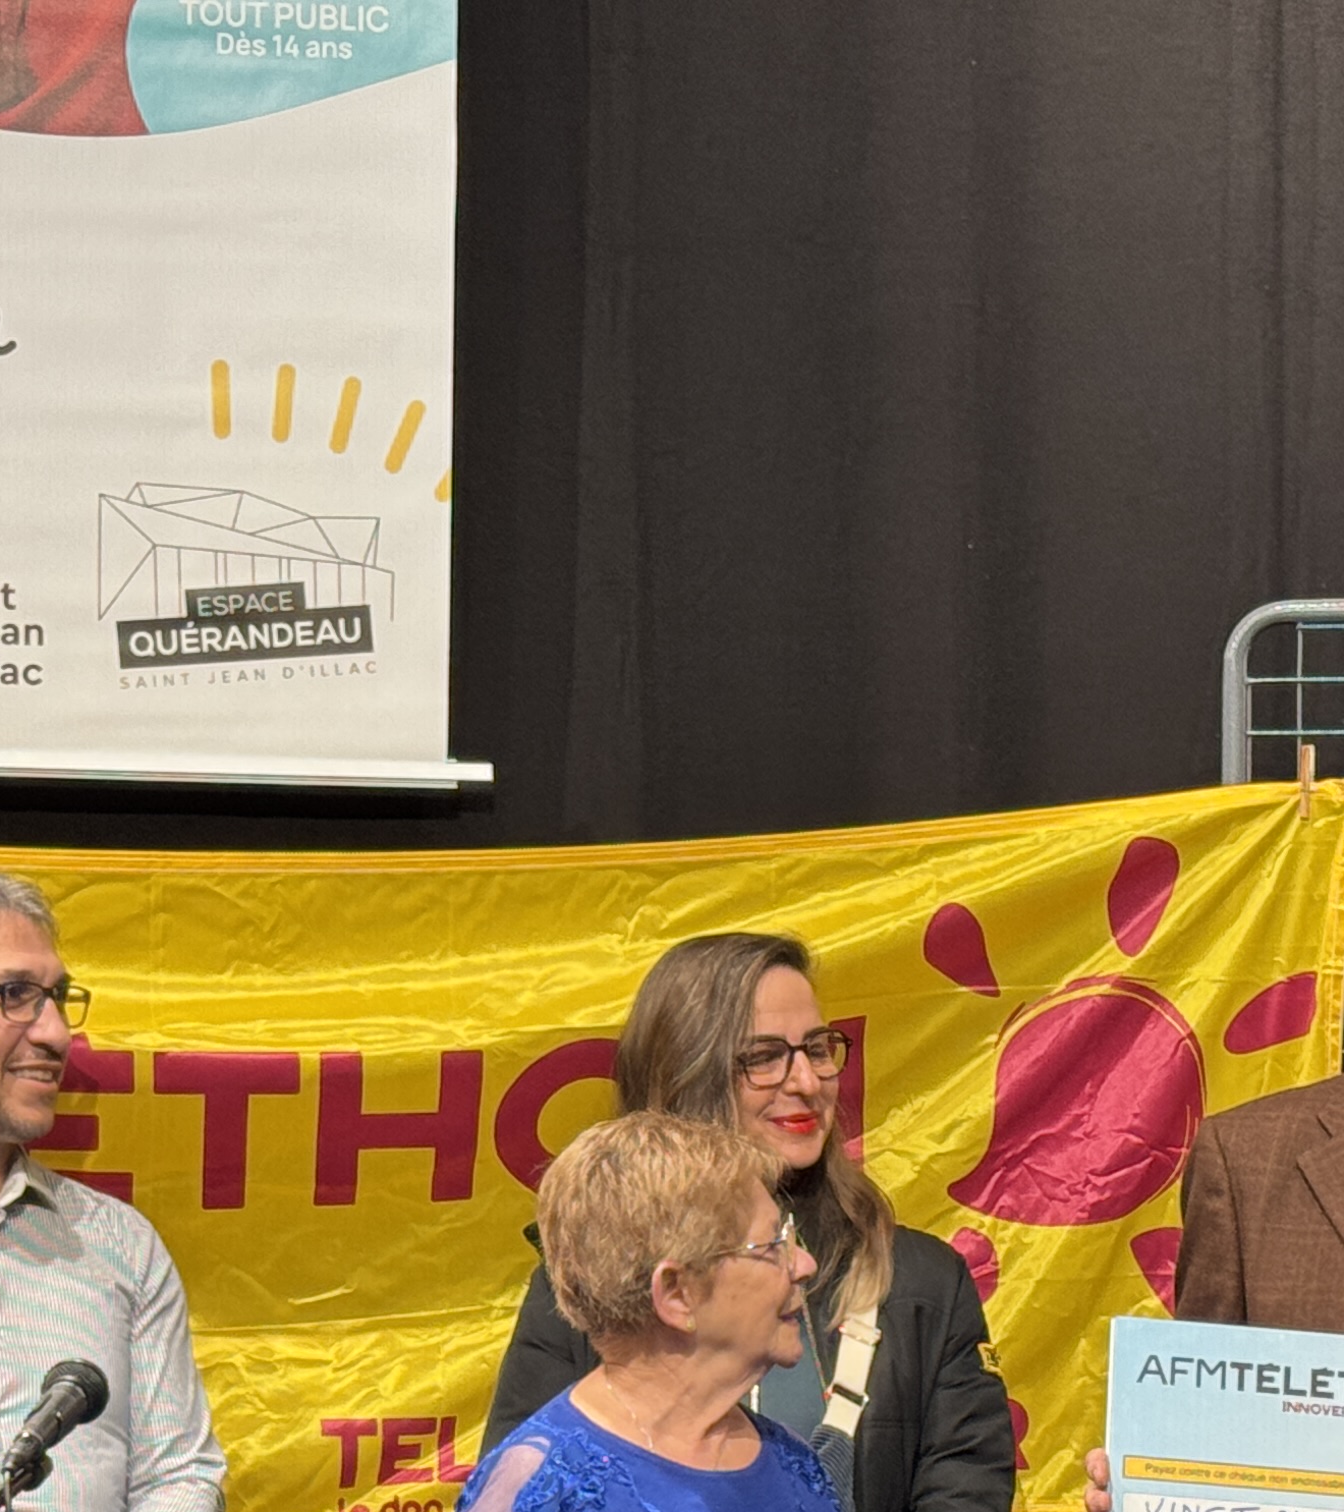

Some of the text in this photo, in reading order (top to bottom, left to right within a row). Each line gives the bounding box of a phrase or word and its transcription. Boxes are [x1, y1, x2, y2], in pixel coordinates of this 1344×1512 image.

[179, 0, 389, 33] TOUT PUBLIC
[216, 30, 353, 60] Dès 14 ans
[197, 590, 294, 617] ESPACE
[129, 617, 362, 657] QUÉRANDEAU
[120, 661, 377, 690] SAINT JEAN D'ILLAC
[1145, 1462, 1175, 1476] Payez
